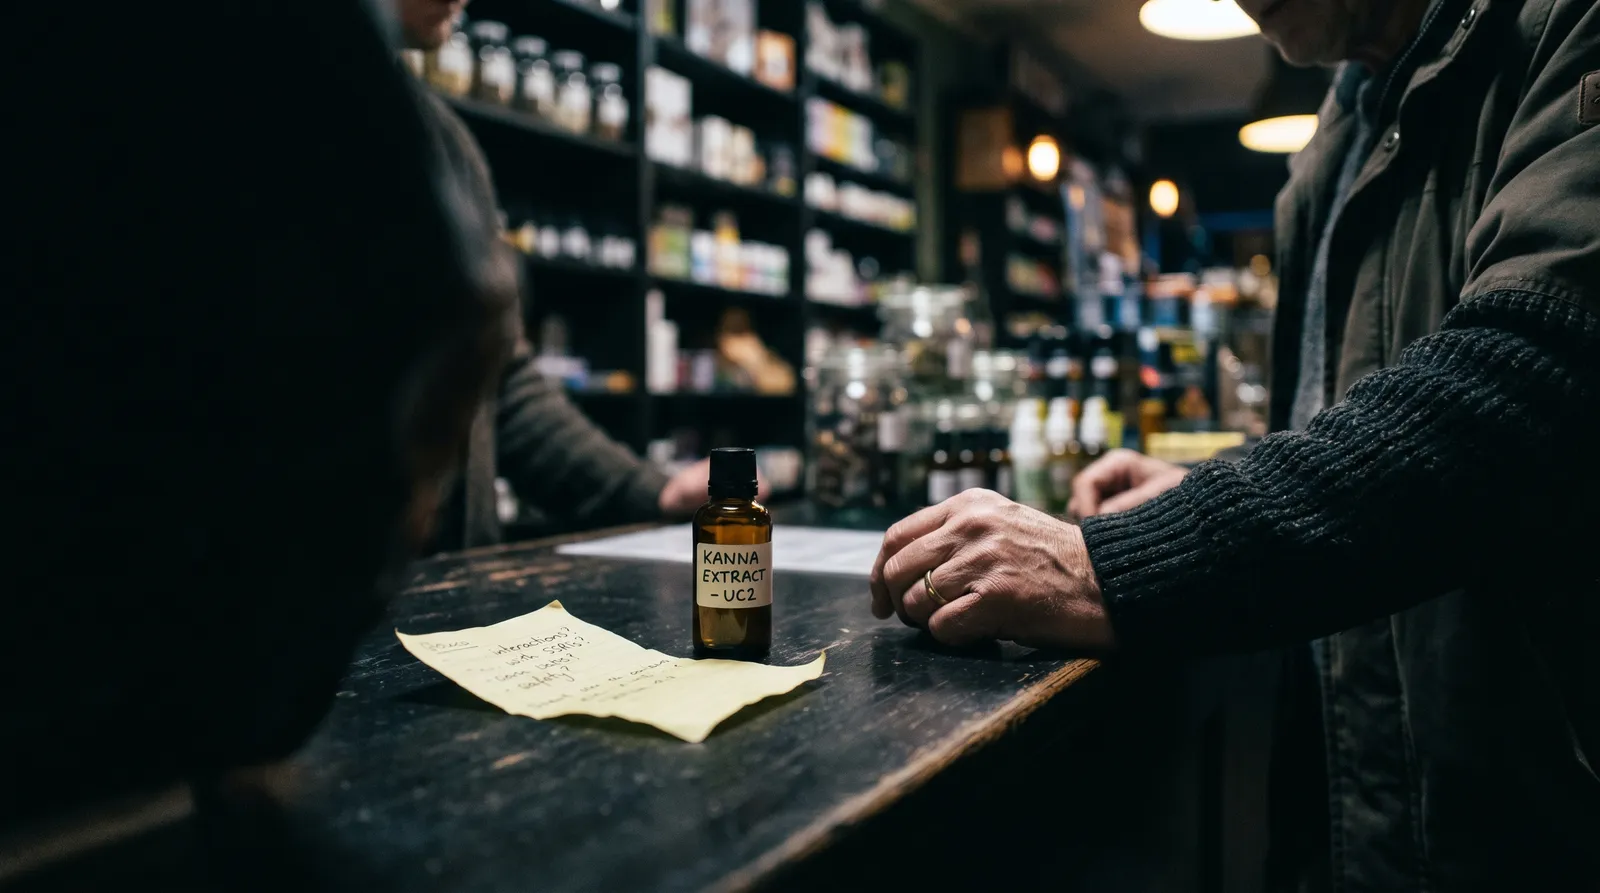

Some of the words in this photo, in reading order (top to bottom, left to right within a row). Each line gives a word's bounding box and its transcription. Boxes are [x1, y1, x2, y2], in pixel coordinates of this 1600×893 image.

[703, 549, 759, 565] KANNA
[702, 568, 766, 583] EXTRACT
[723, 588, 757, 602] UC2
